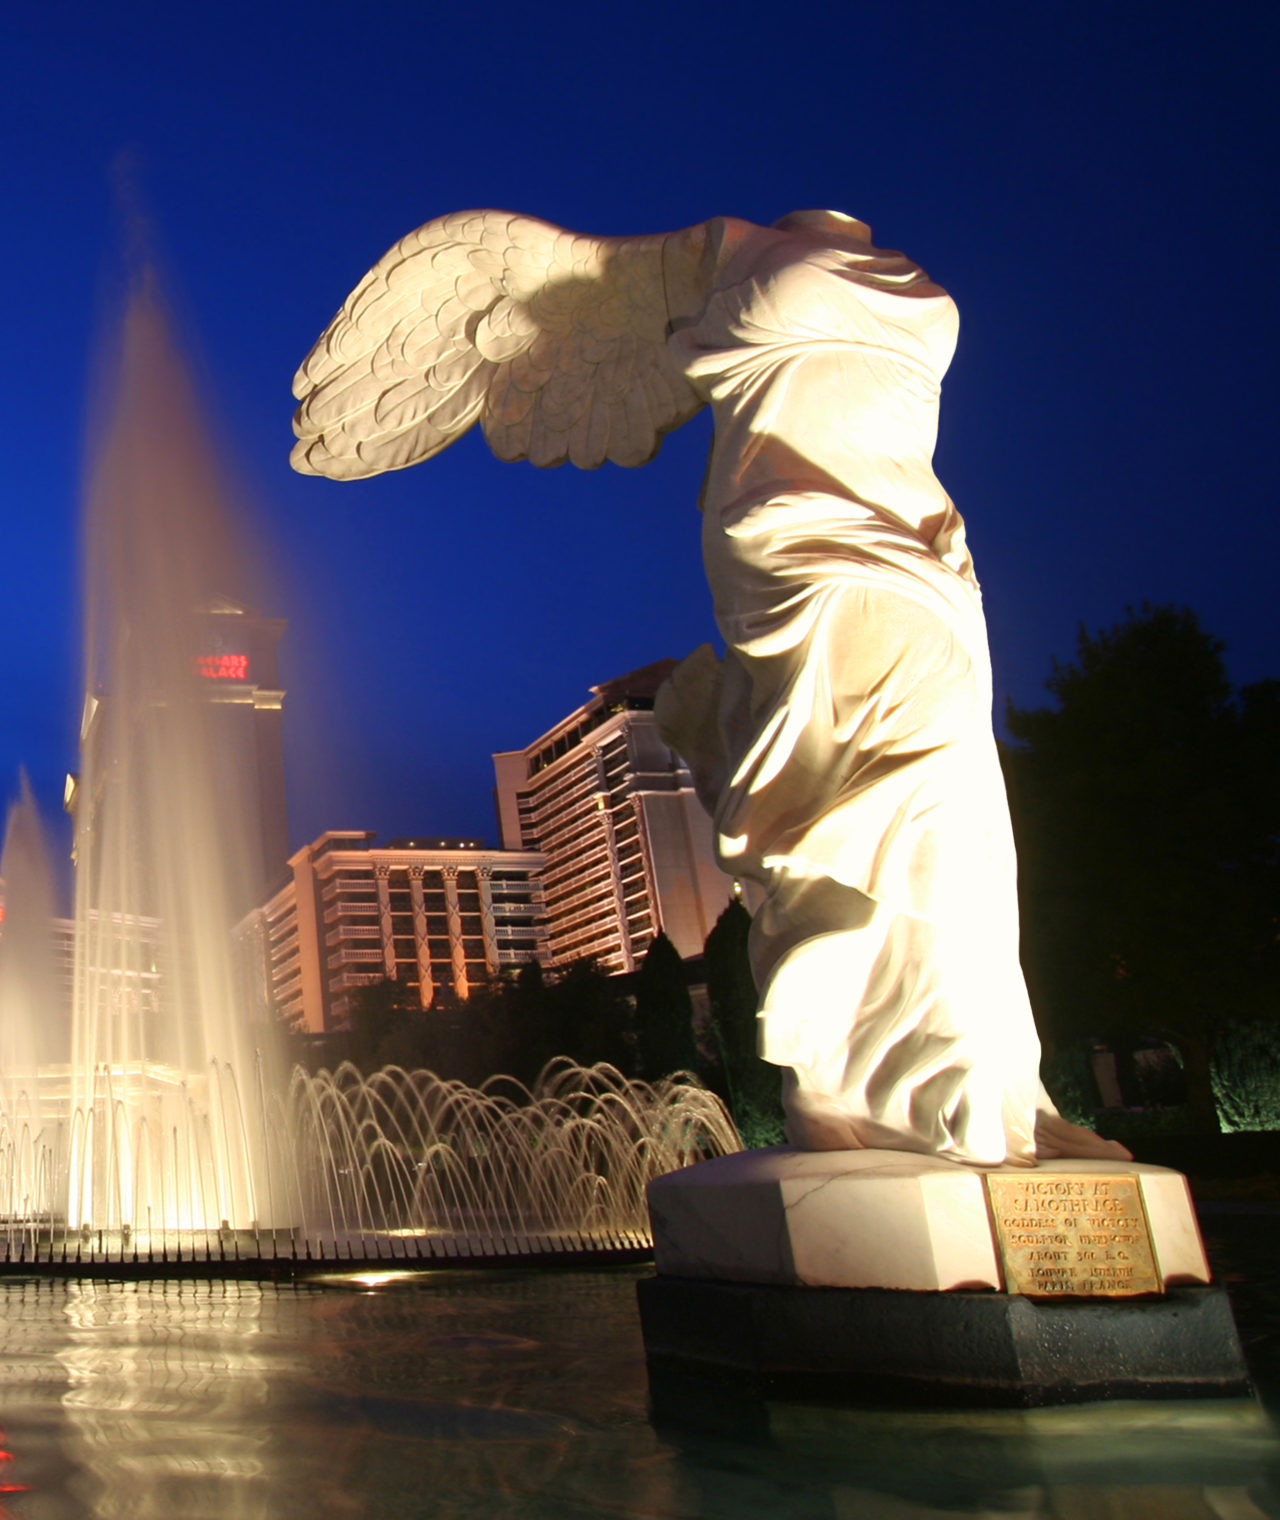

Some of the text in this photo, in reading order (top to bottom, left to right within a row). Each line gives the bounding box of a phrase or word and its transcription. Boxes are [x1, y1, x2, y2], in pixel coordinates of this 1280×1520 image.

[1017, 1182, 1110, 1195] VICTORY AT
[1014, 1198, 1124, 1213] SAMOTHRACE
[1004, 1217, 1057, 1228] GODDESS
[1064, 1217, 1078, 1228] OF
[1028, 1250, 1069, 1261] ABOUT
